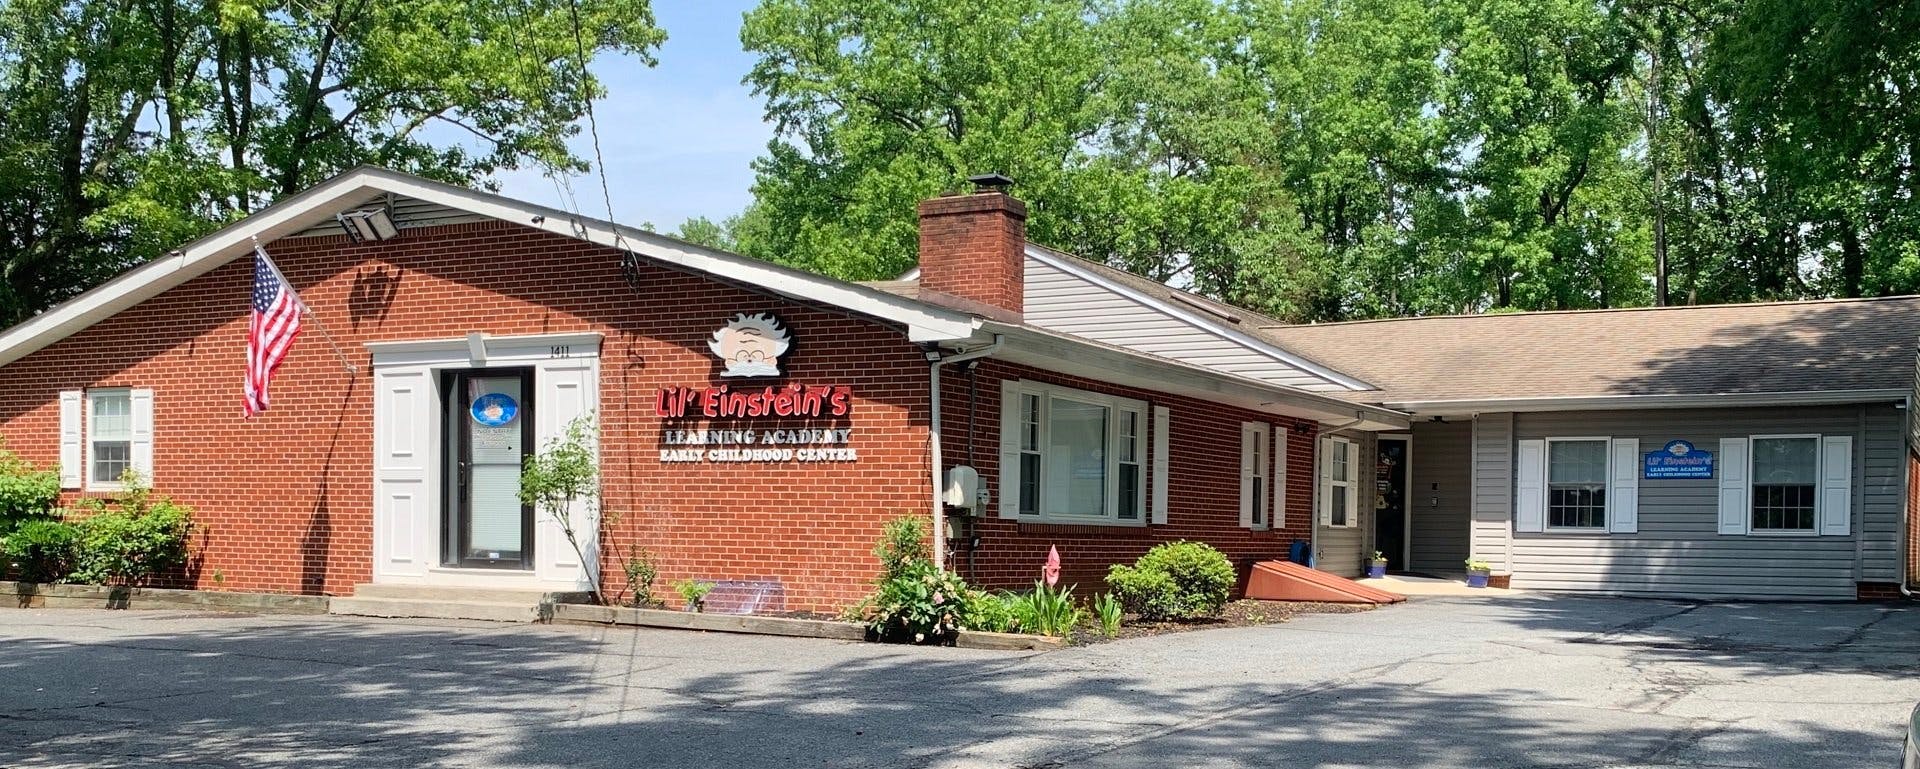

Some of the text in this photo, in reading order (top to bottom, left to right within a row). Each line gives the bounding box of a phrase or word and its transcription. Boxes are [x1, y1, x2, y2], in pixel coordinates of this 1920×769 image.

[551, 346, 570, 359] 1411
[655, 384, 848, 418] Lil' Einstein's
[665, 429, 852, 445] LEARNING ACADEMY
[660, 448, 858, 462] EARLY CHILDHOOD CENTER
